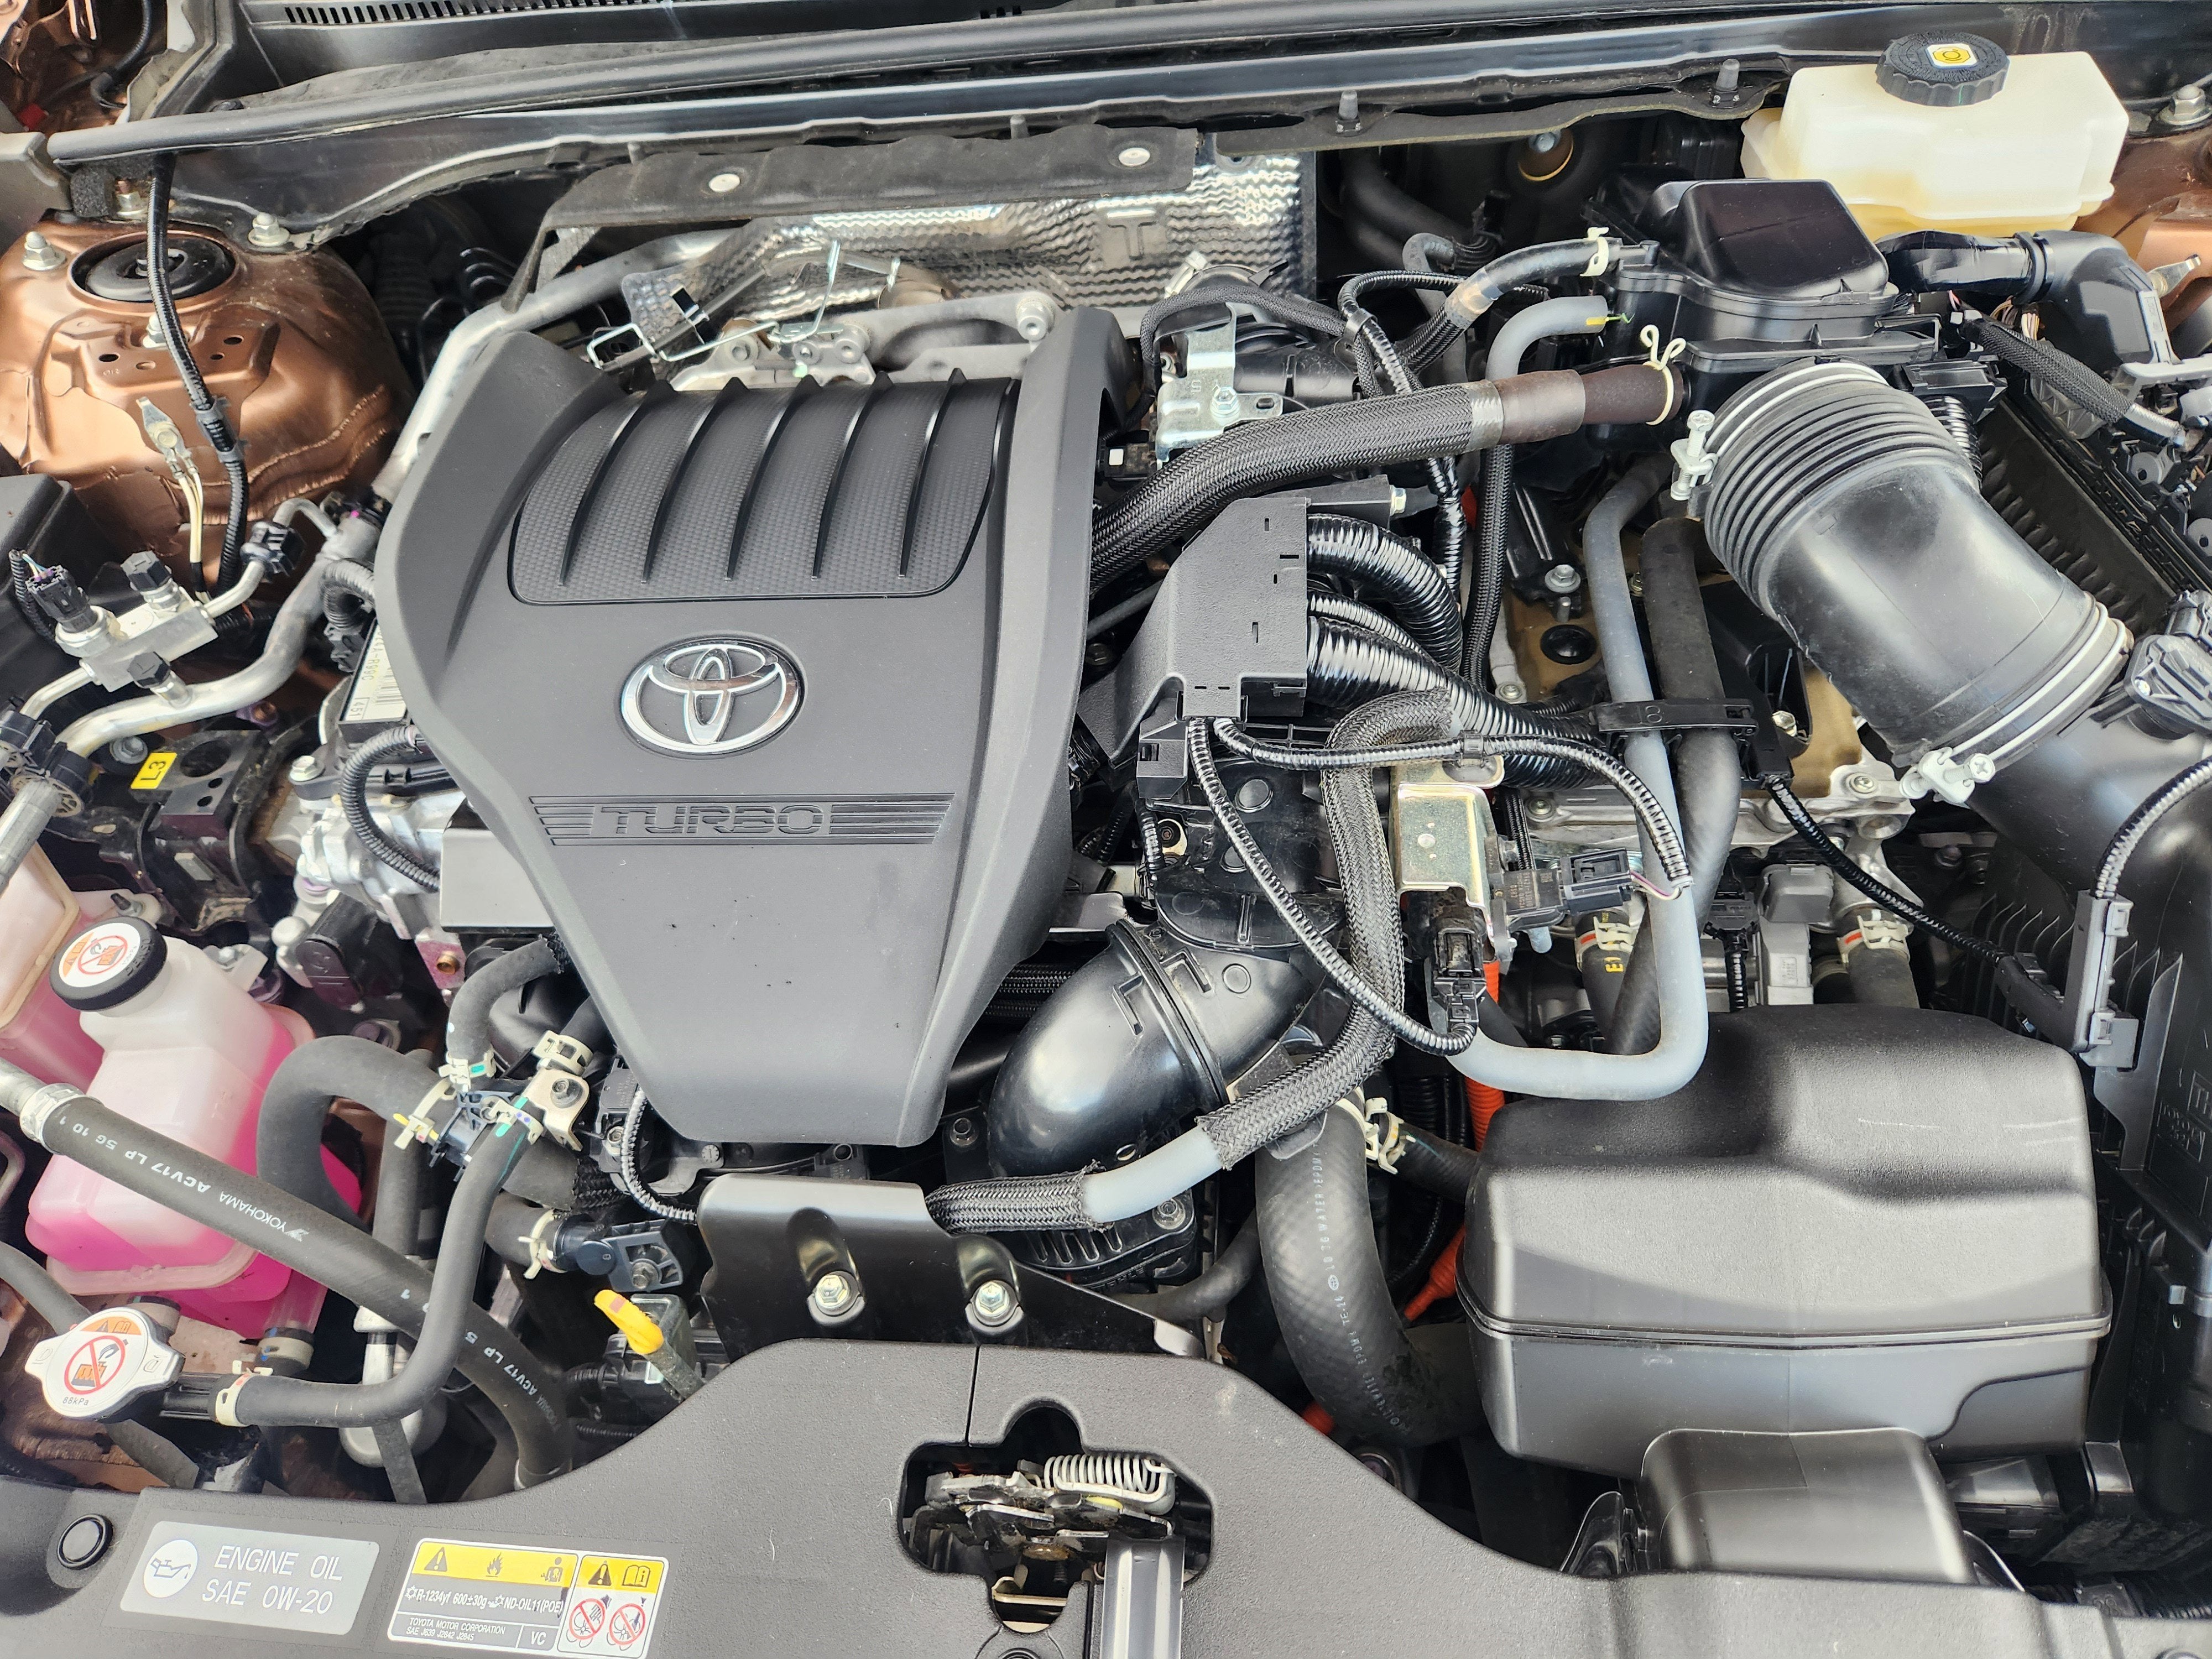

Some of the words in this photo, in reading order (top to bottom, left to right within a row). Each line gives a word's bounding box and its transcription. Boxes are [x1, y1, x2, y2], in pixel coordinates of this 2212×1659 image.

[140, 761, 166, 780] L3
[600, 805, 826, 834] TURBO
[72, 1123, 90, 1138] 10
[95, 1134, 118, 1150] 5G
[125, 1150, 148, 1165] LP
[151, 1162, 212, 1193] ACV17
[219, 1191, 287, 1234] YOKOHAMA
[1315, 1193, 1328, 1232] WATER
[483, 1347, 504, 1364] LP
[503, 1364, 538, 1396] ACV17
[62, 1396, 89, 1406] 88kPa
[214, 1545, 299, 1575] ENGINE
[310, 1555, 343, 1581] OIL
[202, 1579, 251, 1605] SAE
[262, 1585, 333, 1615] 0W-20
[416, 1589, 451, 1604] R-1234yf
[453, 1594, 487, 1610] 600±30g
[504, 1598, 564, 1614] ND-OIL11(POE)
[406, 1627, 419, 1636] SAE
[420, 1628, 435, 1638] J639
[436, 1630, 456, 1639] J2842
[457, 1631, 474, 1641] J2845
[409, 1618, 434, 1627] TOYOTA
[436, 1620, 460, 1630] MOTOR
[461, 1622, 505, 1635] CORPORATION
[530, 1631, 546, 1646] VC
